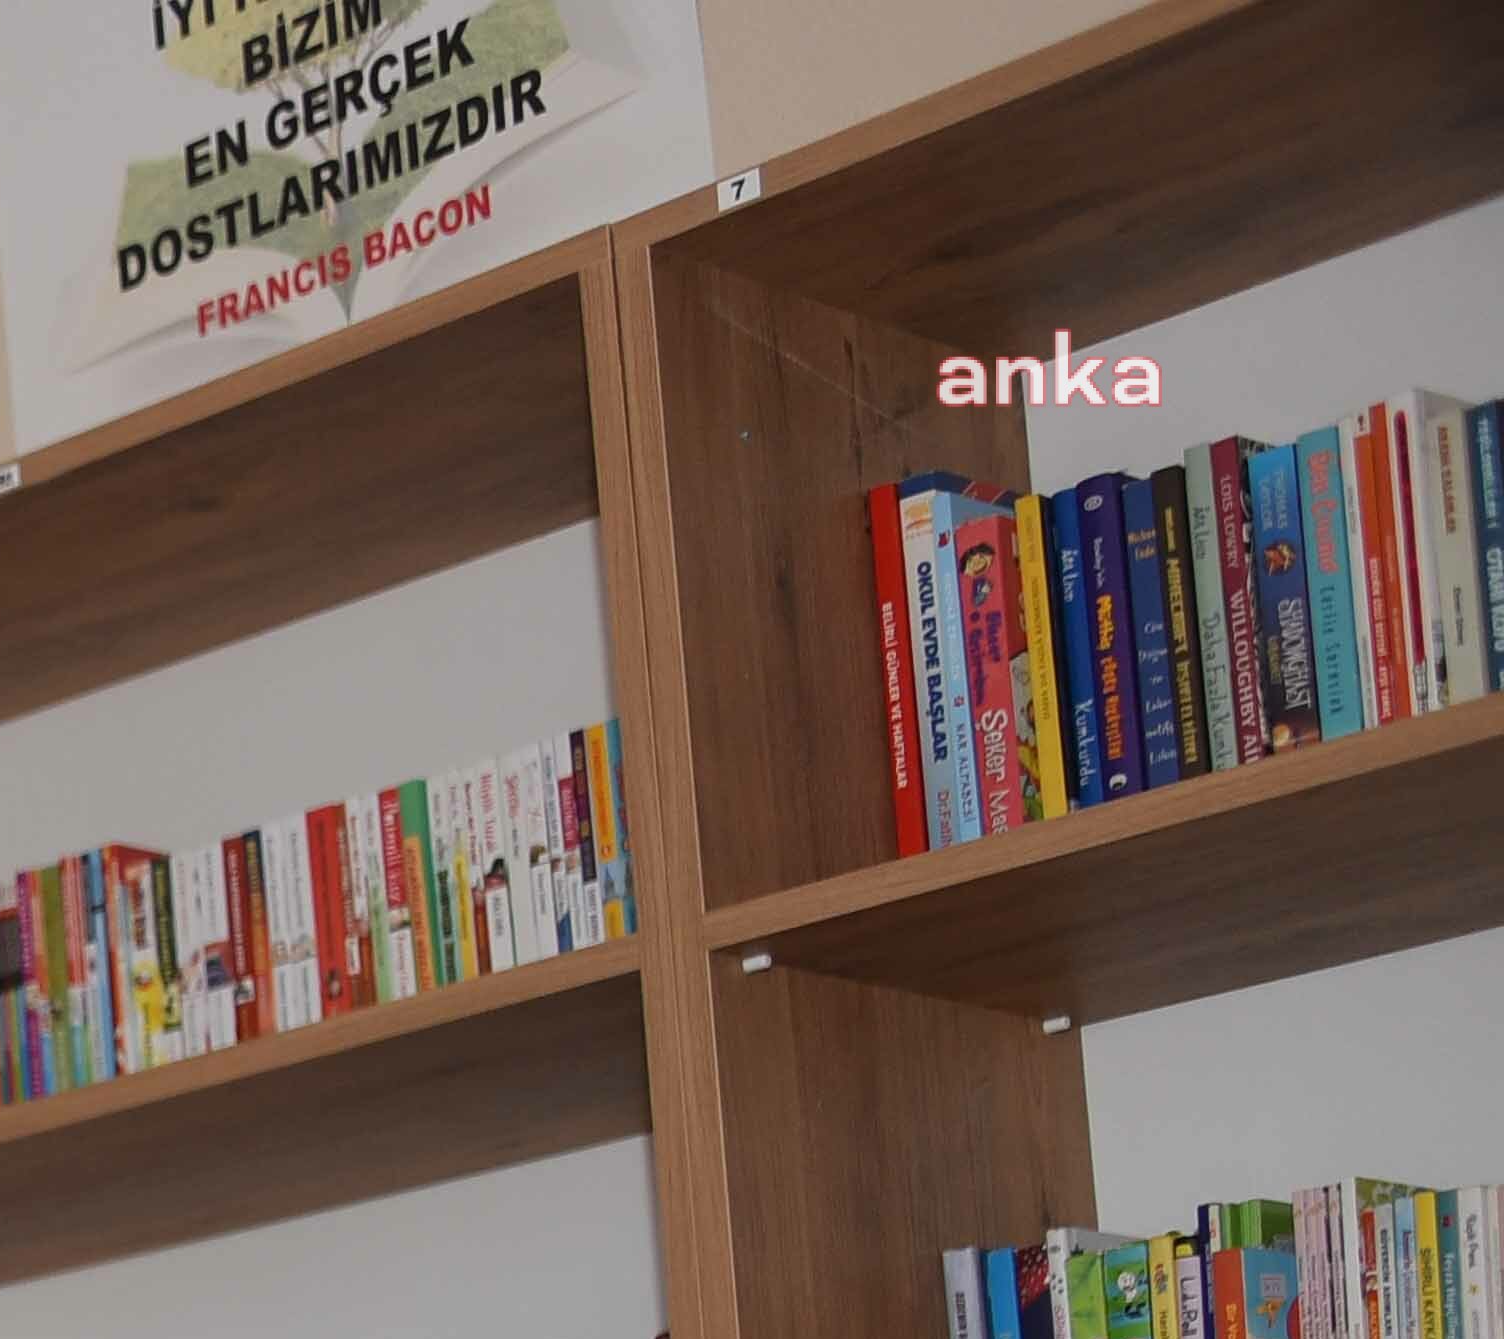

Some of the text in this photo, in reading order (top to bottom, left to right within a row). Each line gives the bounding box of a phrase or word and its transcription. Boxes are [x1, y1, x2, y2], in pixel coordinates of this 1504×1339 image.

[242, 0, 383, 88] BİZİM
[185, 20, 476, 188] EN GERÇEK
[116, 69, 548, 291] DOSTLARIMIZDIR
[731, 180, 745, 202] 7
[196, 187, 495, 336] FRANCIS BACON
[1224, 519, 1240, 568] LOWRY
[885, 650, 904, 701] GÜNLER
[917, 562, 947, 763] OKUL EVDE BAŞLAR
[1228, 590, 1256, 726] WILLOUGHBY
[889, 704, 901, 720] VE
[974, 709, 1009, 782] Şeker
[1067, 700, 1095, 788] Kumkurdu
[892, 724, 908, 789] HAFTALAR
